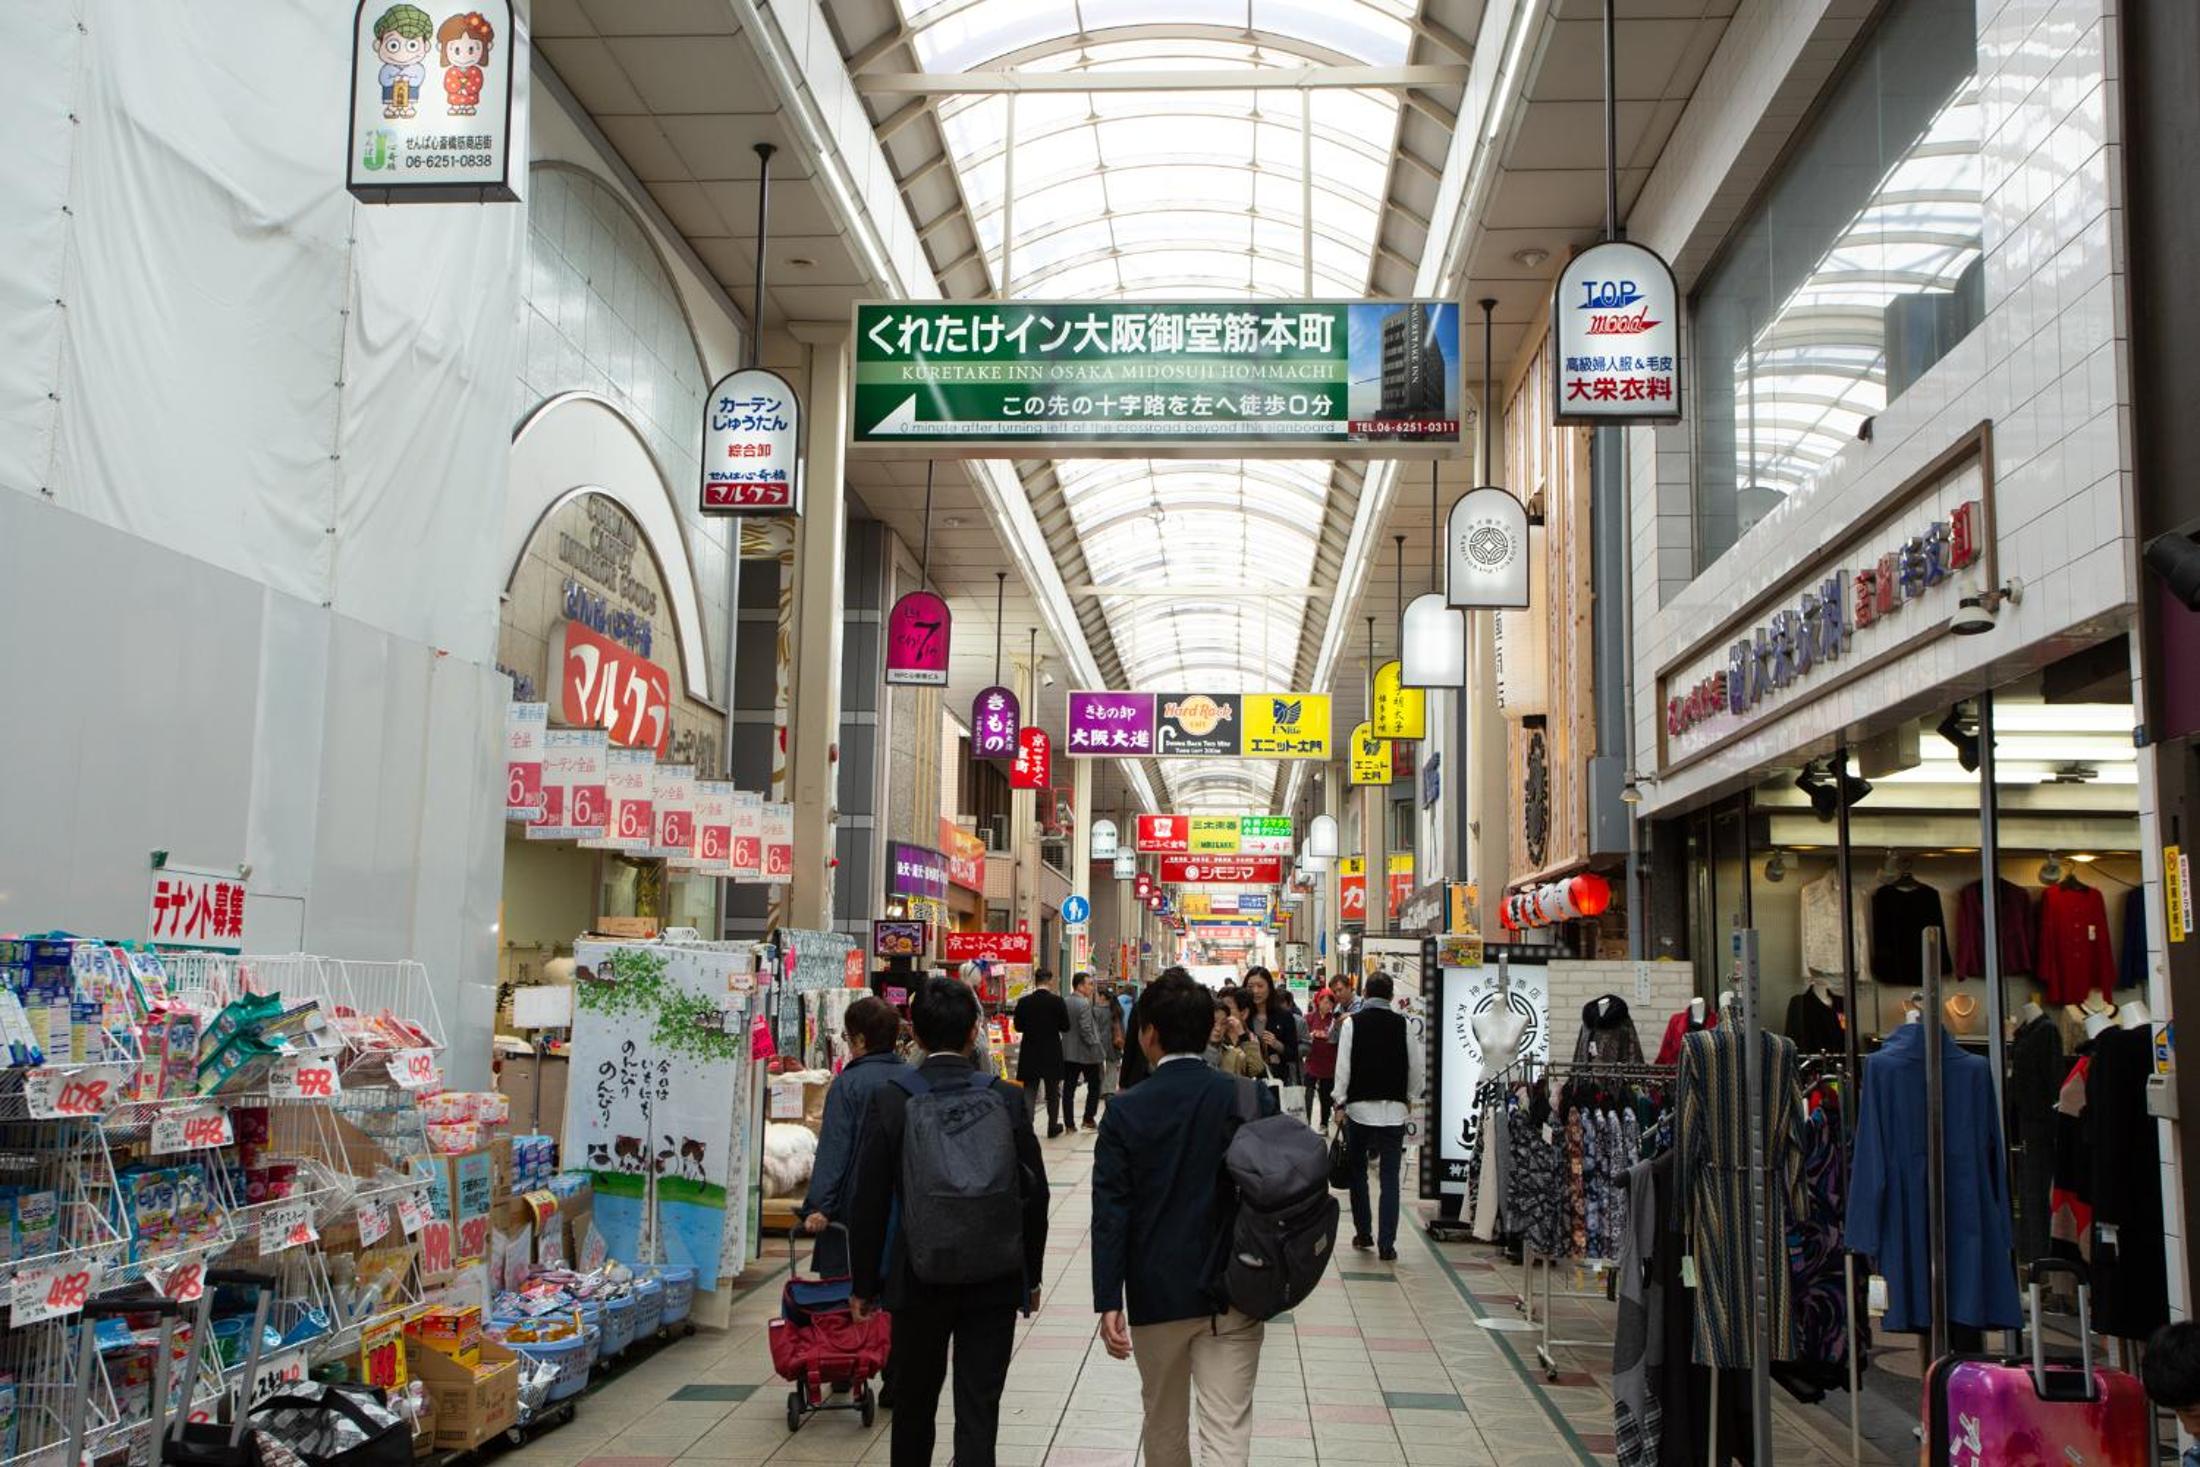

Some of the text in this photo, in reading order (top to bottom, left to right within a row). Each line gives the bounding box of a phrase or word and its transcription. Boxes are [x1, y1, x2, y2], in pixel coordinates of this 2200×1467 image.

[405, 154, 492, 168] 06-6251-0838
[1582, 281, 1637, 307] TOP
[1590, 305, 1649, 334] mood
[867, 312, 1335, 355] くれたけイン大阪御堂筋本町
[902, 364, 1335, 380] KURETAKE INN OSAKA MIDOSUJI HOMMACHI
[1567, 376, 1673, 401] 大栄衣料
[720, 397, 782, 413] カーテン
[713, 415, 788, 431] じゅうたん
[962, 421, 992, 433] after
[997, 422, 1043, 436] turning
[1047, 421, 1069, 433] left
[1072, 421, 1087, 433] of
[1090, 421, 1113, 433] the
[1117, 421, 1182, 433] crossroad
[1185, 421, 1239, 436] beyond
[1241, 421, 1264, 433] this
[1356, 421, 1456, 433] TEL.06-6251-0311
[709, 485, 784, 503] マルクラ
[914, 621, 942, 662] 7
[570, 643, 667, 750] マルクラ
[1085, 704, 1136, 720] きもの卸
[1163, 702, 1198, 719] Hard
[985, 692, 1005, 752] きもの
[1070, 728, 1149, 748] 大阪大進
[1201, 866, 1254, 880] シモジマ
[153, 880, 245, 940] テナント募集
[621, 1039, 638, 1100] のんびり
